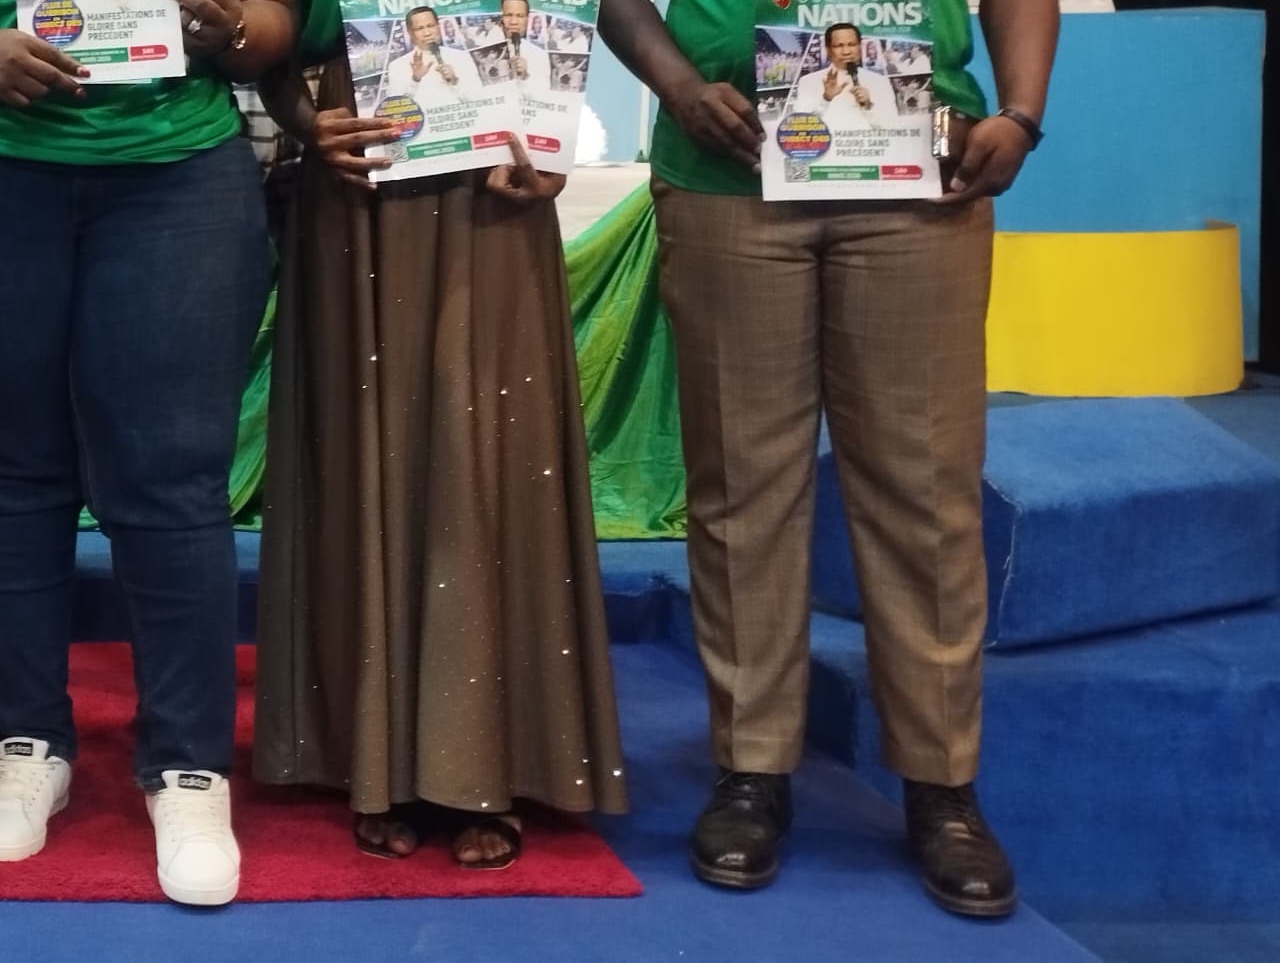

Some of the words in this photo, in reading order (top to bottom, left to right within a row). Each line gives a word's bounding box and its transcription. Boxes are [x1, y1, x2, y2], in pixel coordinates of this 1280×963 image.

[86, 10, 154, 22] MANIFESTATIONS
[156, 9, 167, 18] DE
[797, 1, 923, 28] NATIONS
